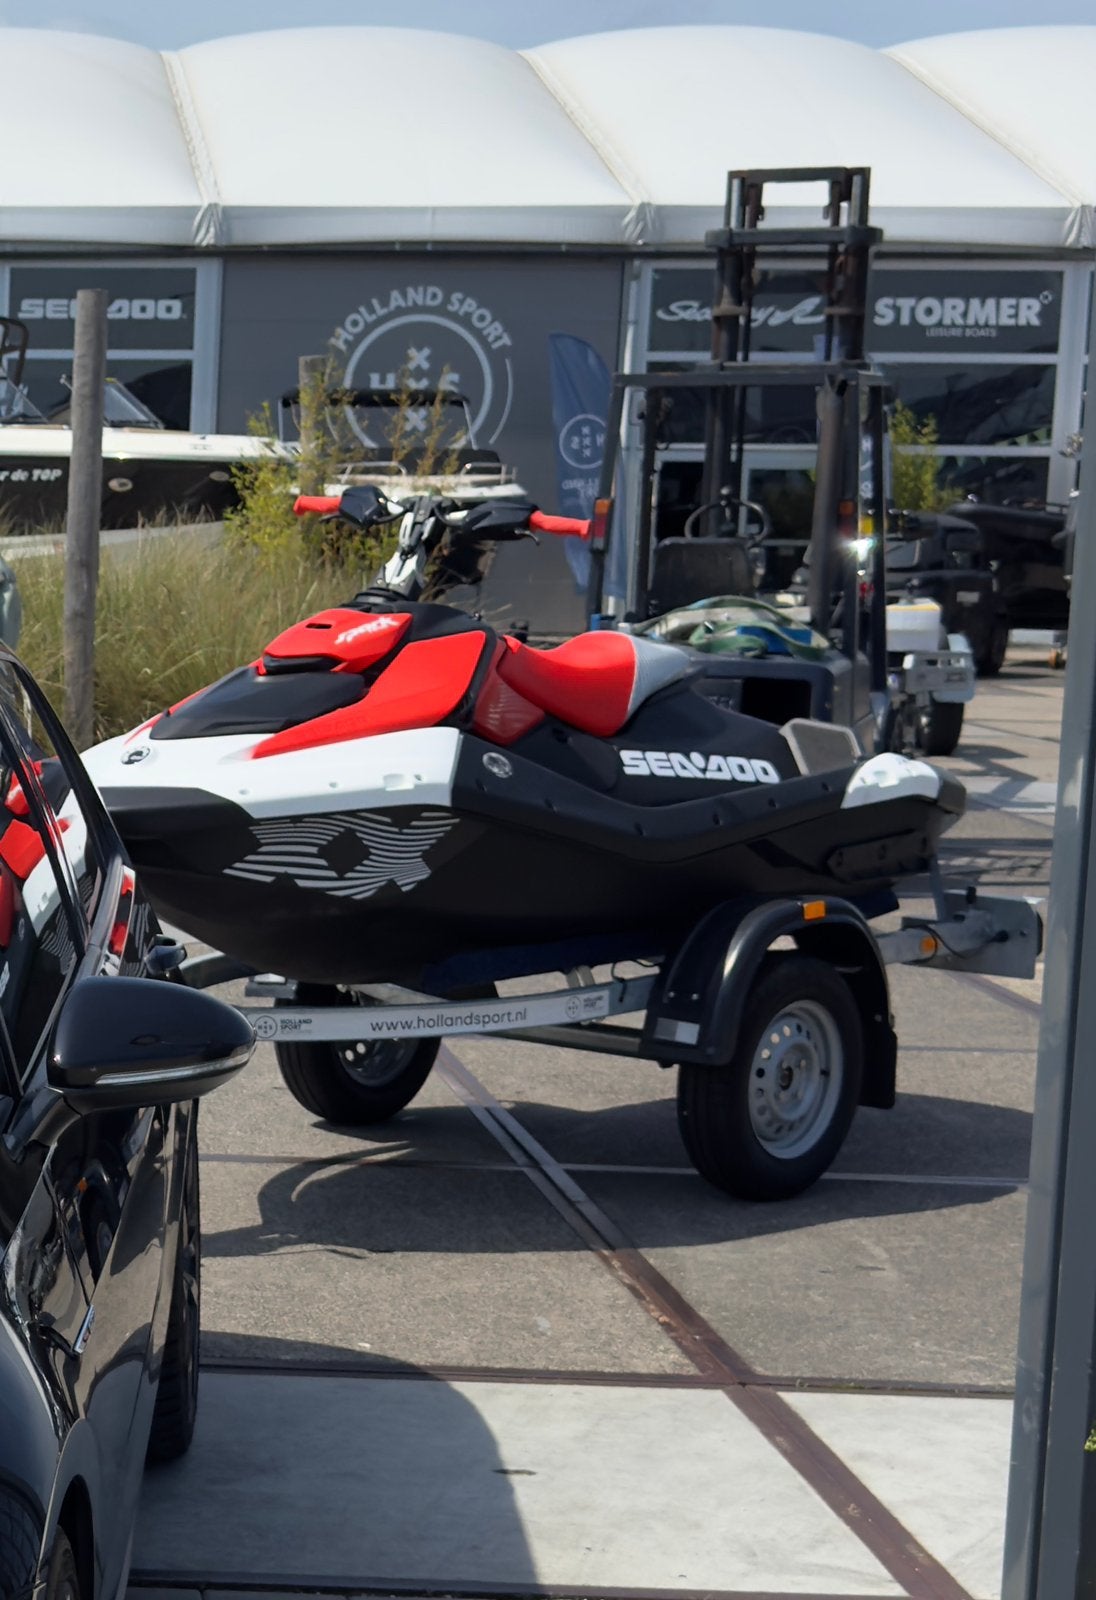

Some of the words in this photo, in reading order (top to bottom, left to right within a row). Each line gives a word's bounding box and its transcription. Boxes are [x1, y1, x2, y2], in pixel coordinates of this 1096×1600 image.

[327, 286, 443, 352] HOLLAND
[447, 292, 512, 349] SPORT
[873, 297, 1041, 326] STORMER
[32, 468, 62, 481] TOP
[370, 1008, 527, 1031] www.hollandsport.nl
